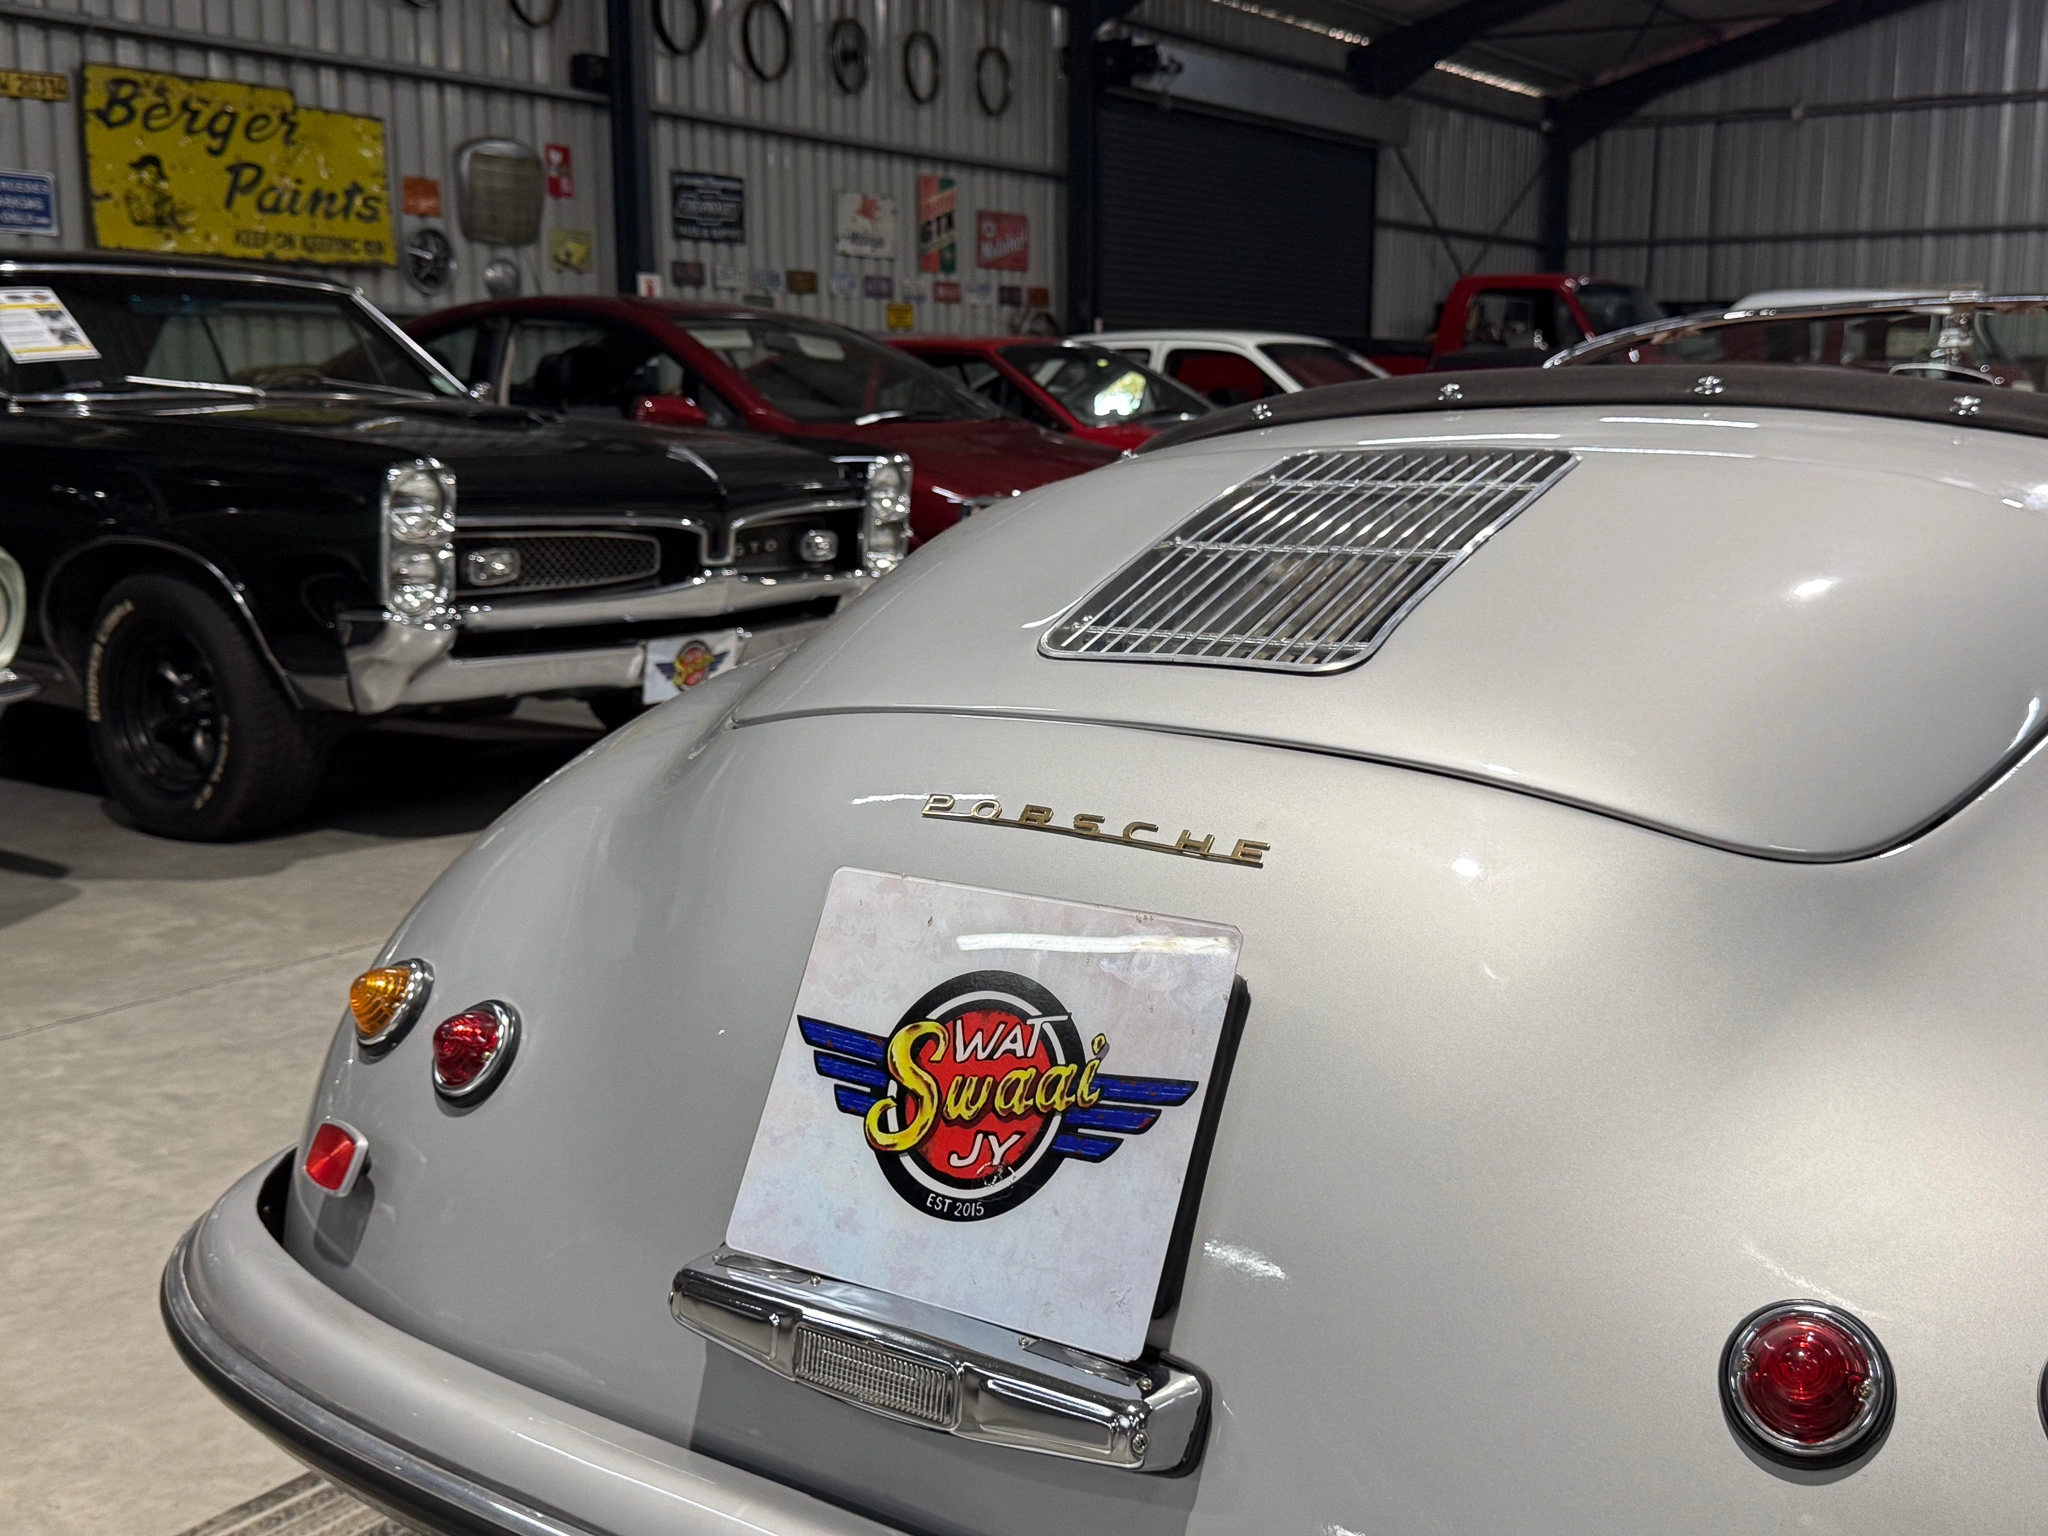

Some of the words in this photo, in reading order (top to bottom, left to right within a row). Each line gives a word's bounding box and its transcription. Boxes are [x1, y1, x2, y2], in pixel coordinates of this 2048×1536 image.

[95, 78, 299, 157] Berger
[224, 161, 383, 224] Paints
[920, 210, 954, 243] GTX
[922, 793, 1272, 868] PORSCHE
[955, 1012, 1072, 1063] WAT
[864, 1020, 1110, 1152] Swaai
[949, 1131, 1026, 1168] JY
[926, 1192, 953, 1213] EST
[954, 1200, 985, 1217] 2015
